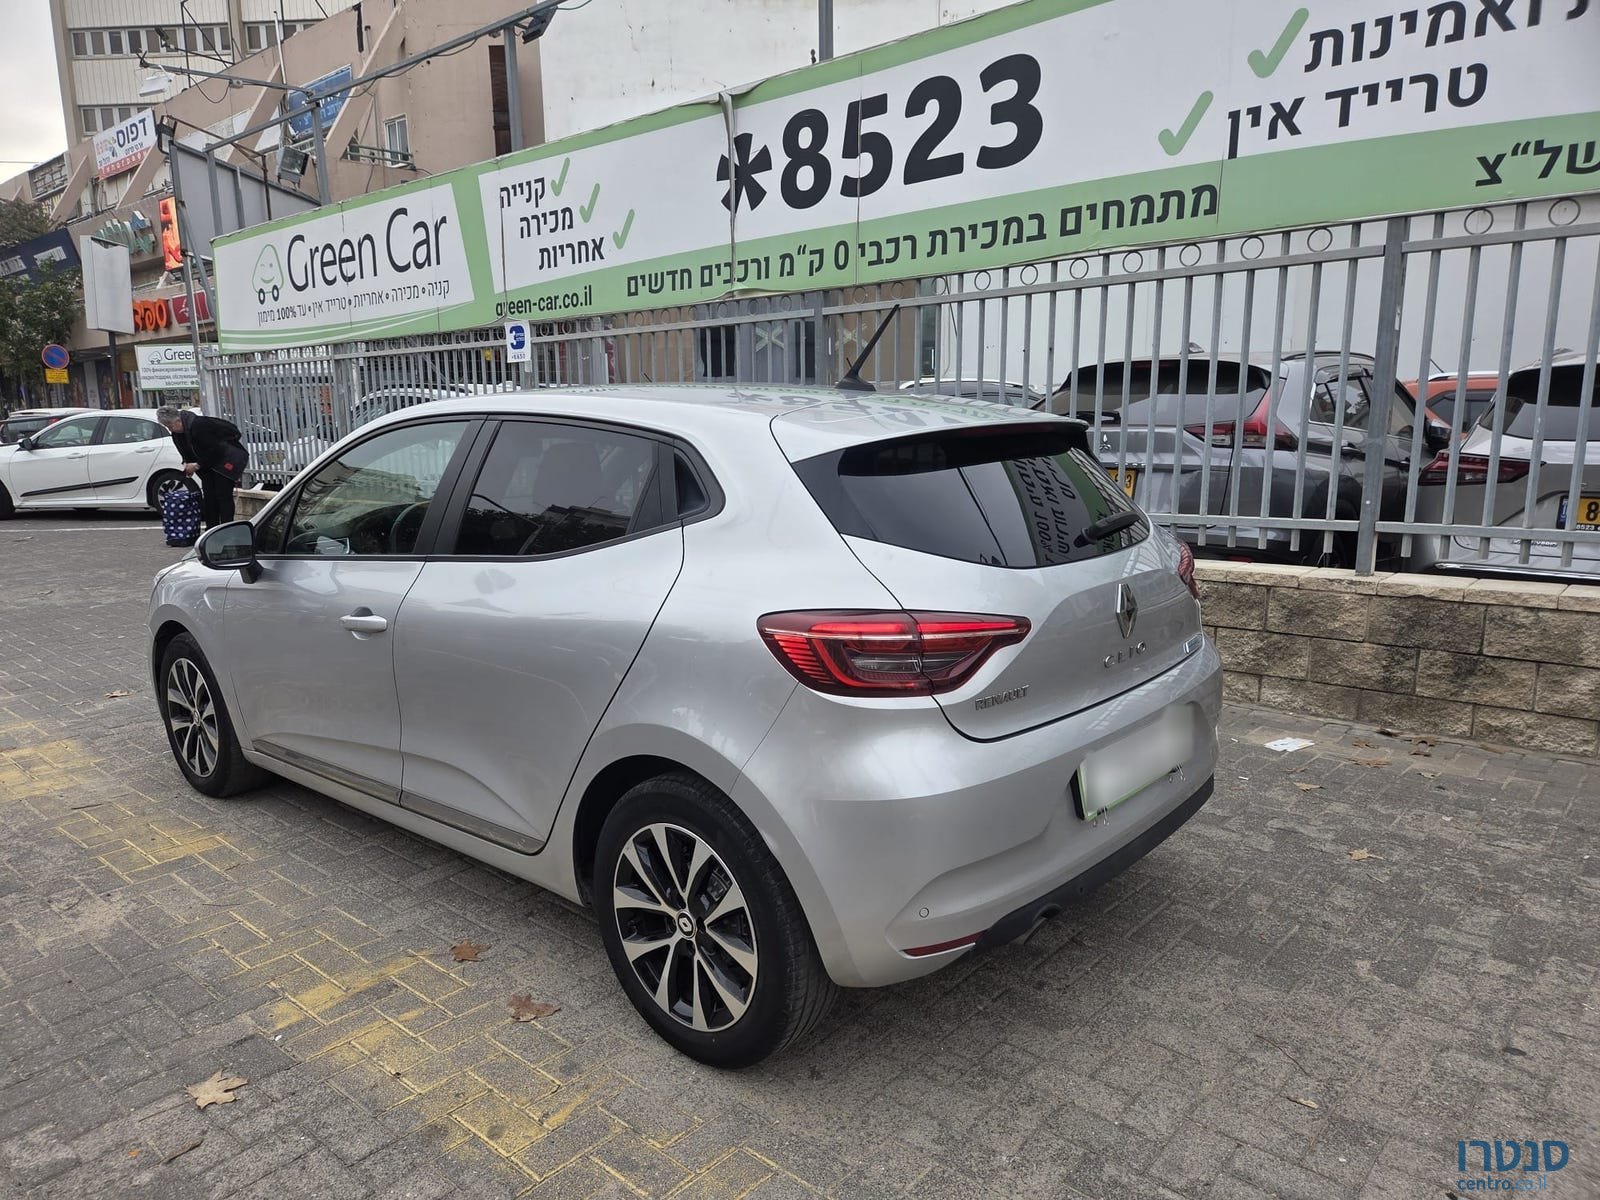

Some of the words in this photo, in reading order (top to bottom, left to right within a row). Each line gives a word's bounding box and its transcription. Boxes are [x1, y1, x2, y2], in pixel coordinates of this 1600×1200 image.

[1325, 63, 1489, 128] טרייד
[116, 117, 147, 148] דפוס
[1227, 96, 1306, 160] אין
[500, 176, 546, 209] קנייה
[520, 206, 574, 239] מכירה
[1060, 183, 1219, 238] מתמחים
[287, 233, 378, 292] Green
[386, 207, 448, 273] Car
[858, 234, 917, 266] רכבי
[927, 213, 1048, 258] במכירת
[539, 236, 606, 271] אחריות
[834, 240, 850, 271] 0
[627, 268, 693, 297] חדשים
[700, 255, 770, 288] ורכבים
[325, 298, 347, 312] טרייד
[353, 290, 385, 308] אחריות
[391, 284, 420, 302] מכירה
[427, 280, 451, 299] קניה
[257, 309, 275, 326] מימון
[276, 306, 297, 321] 100%
[297, 304, 307, 317] עד
[312, 300, 324, 318] אין
[1103, 641, 1147, 669] CLIO
[975, 685, 1030, 711] RENAULT
